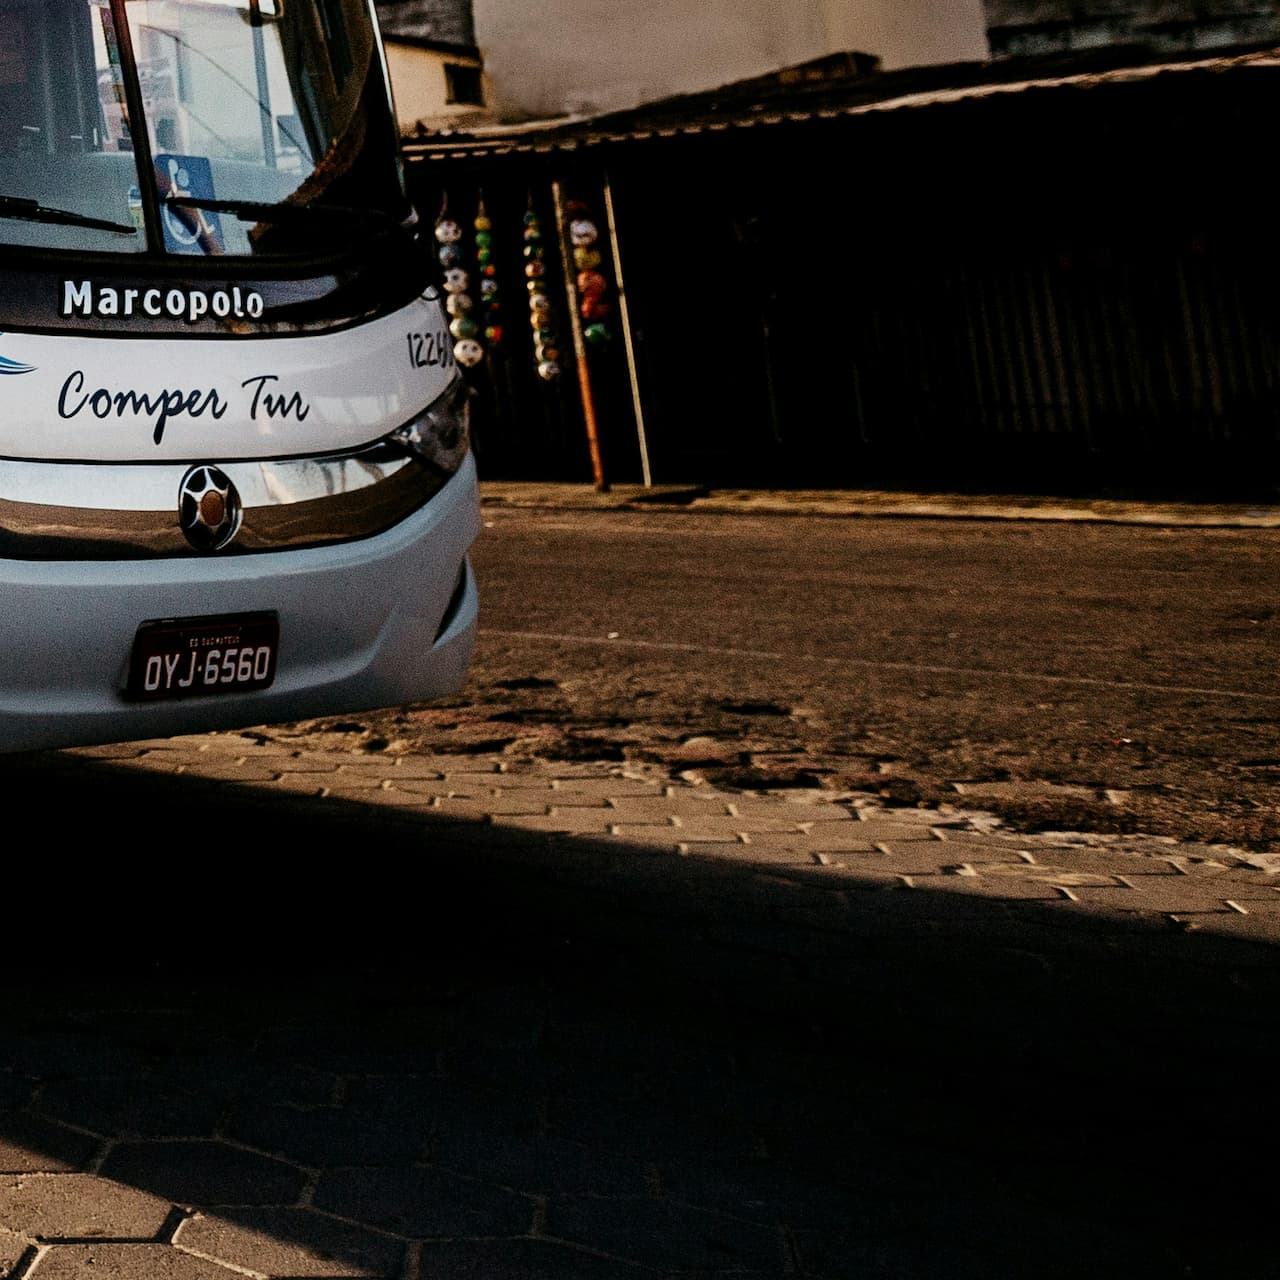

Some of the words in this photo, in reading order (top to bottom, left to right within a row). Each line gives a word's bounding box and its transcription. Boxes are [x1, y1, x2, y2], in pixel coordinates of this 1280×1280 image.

[63, 280, 264, 321] Marcopolo
[58, 370, 228, 446] Comper
[242, 375, 310, 422] Tur
